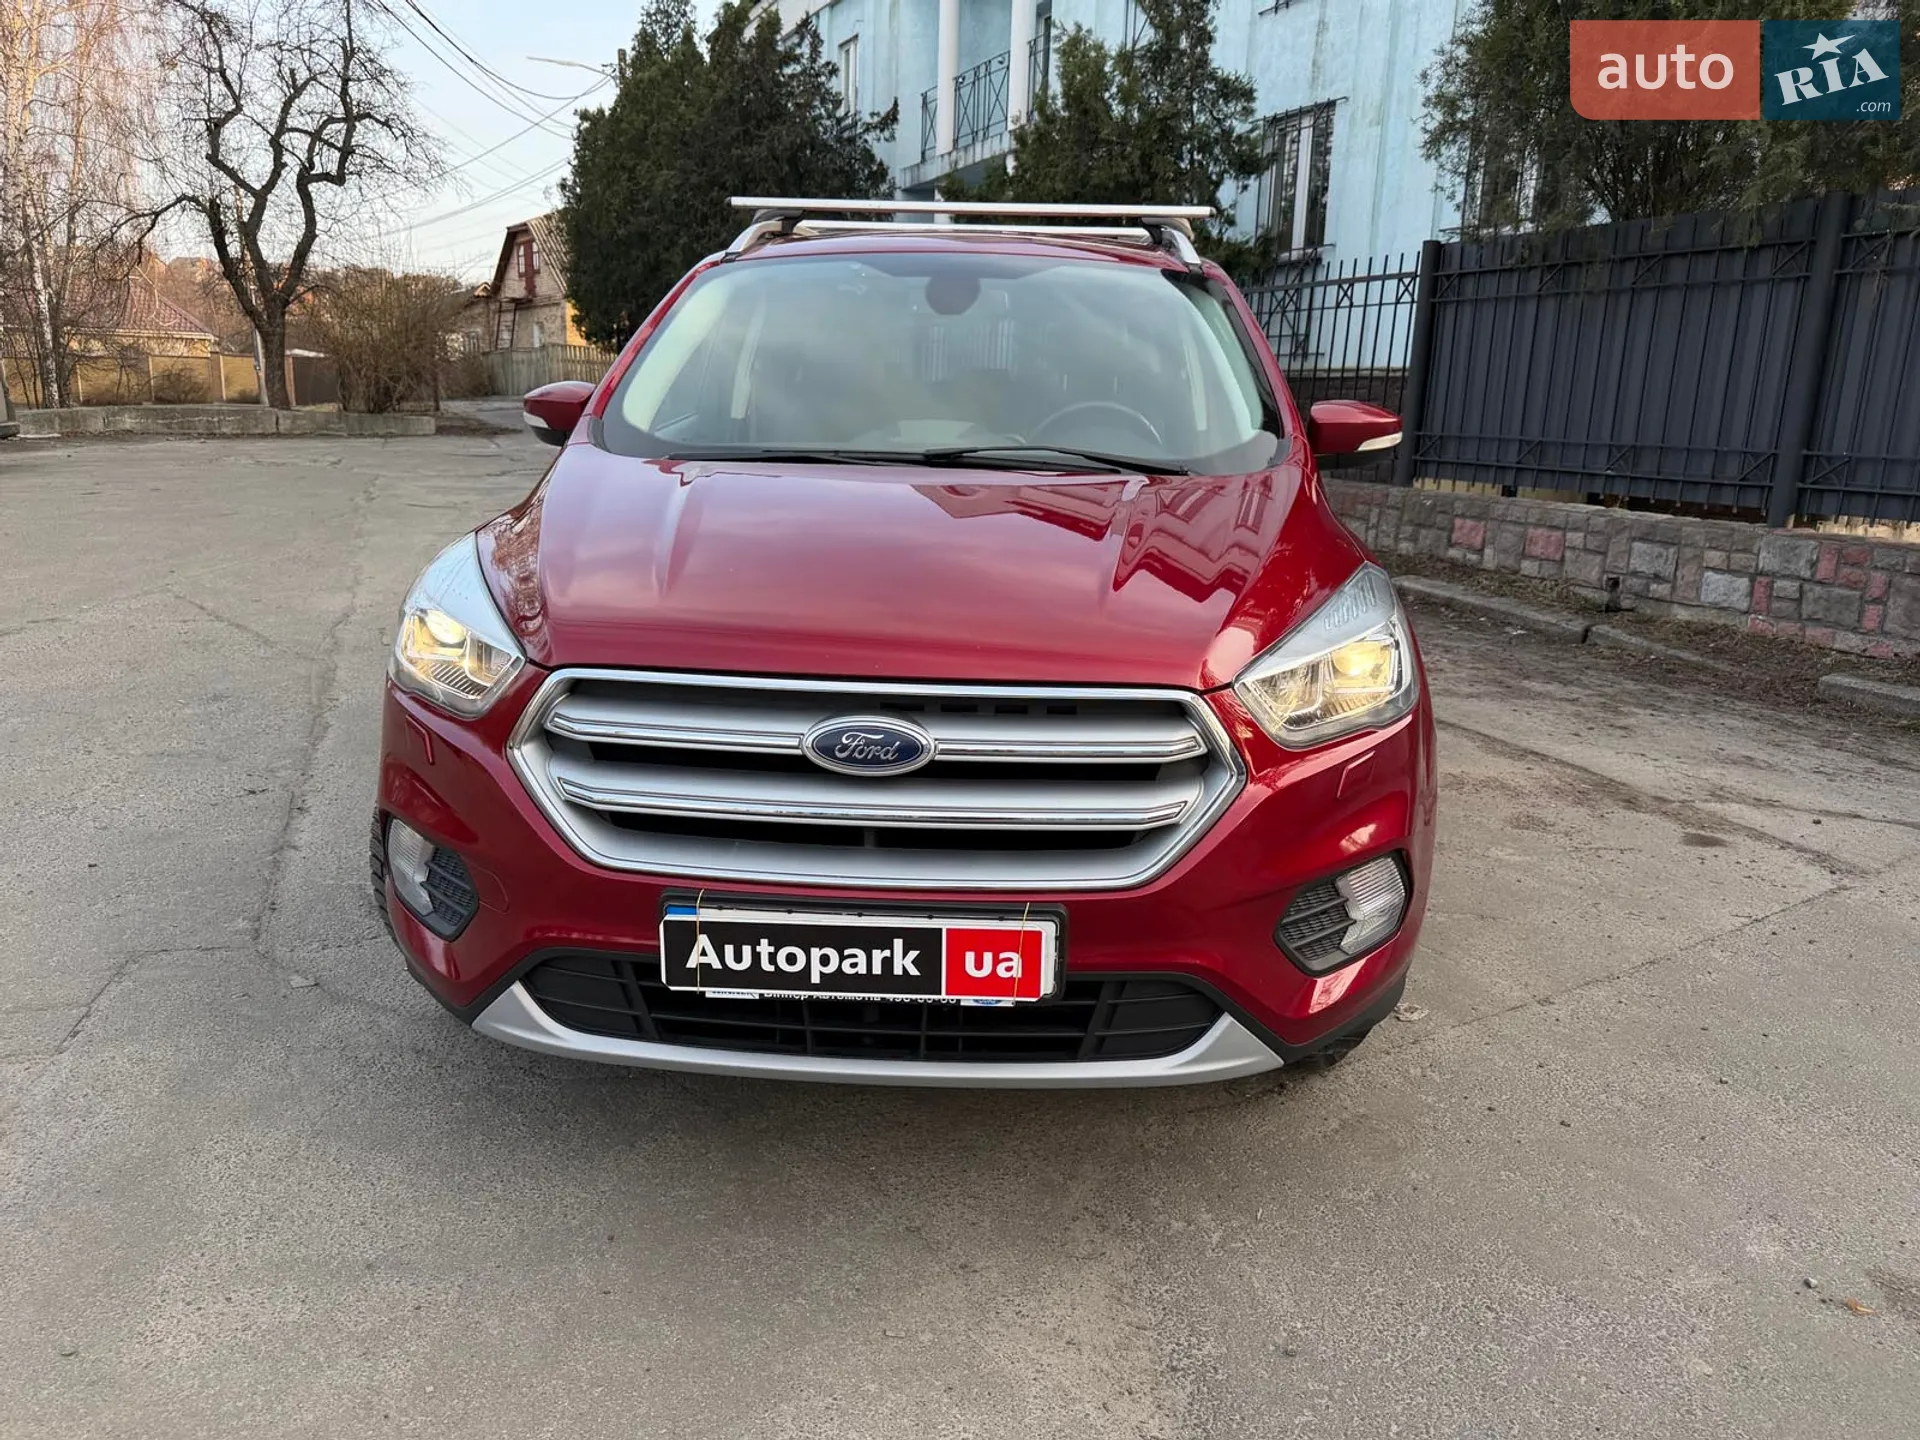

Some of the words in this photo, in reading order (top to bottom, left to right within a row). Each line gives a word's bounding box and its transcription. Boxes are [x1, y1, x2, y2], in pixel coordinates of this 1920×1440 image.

[834, 731, 901, 761] Ford
[685, 933, 922, 984] Autopark
[963, 950, 1023, 979] ua
